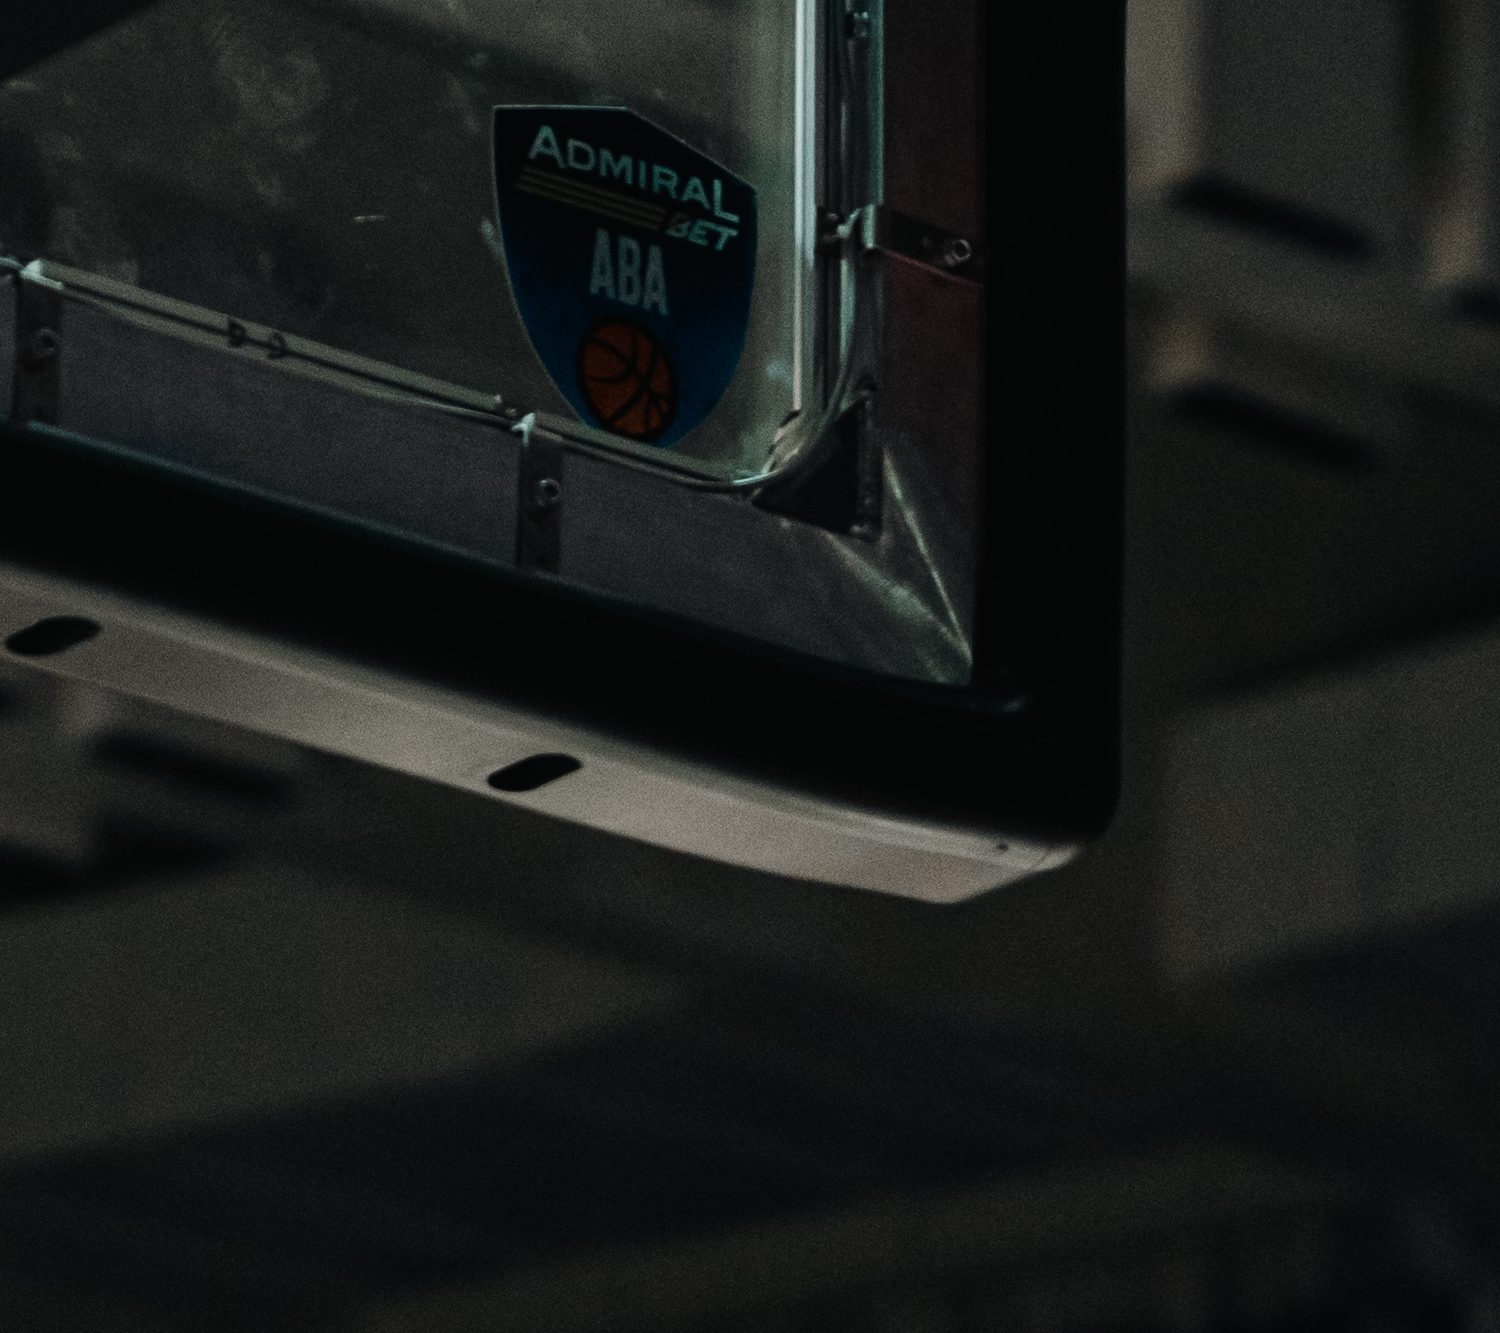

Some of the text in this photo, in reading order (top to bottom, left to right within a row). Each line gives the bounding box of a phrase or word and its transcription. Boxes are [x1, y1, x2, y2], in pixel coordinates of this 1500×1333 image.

[527, 124, 741, 224] ADMIRAL
[588, 227, 670, 317] ABA
[665, 211, 740, 252] BET
